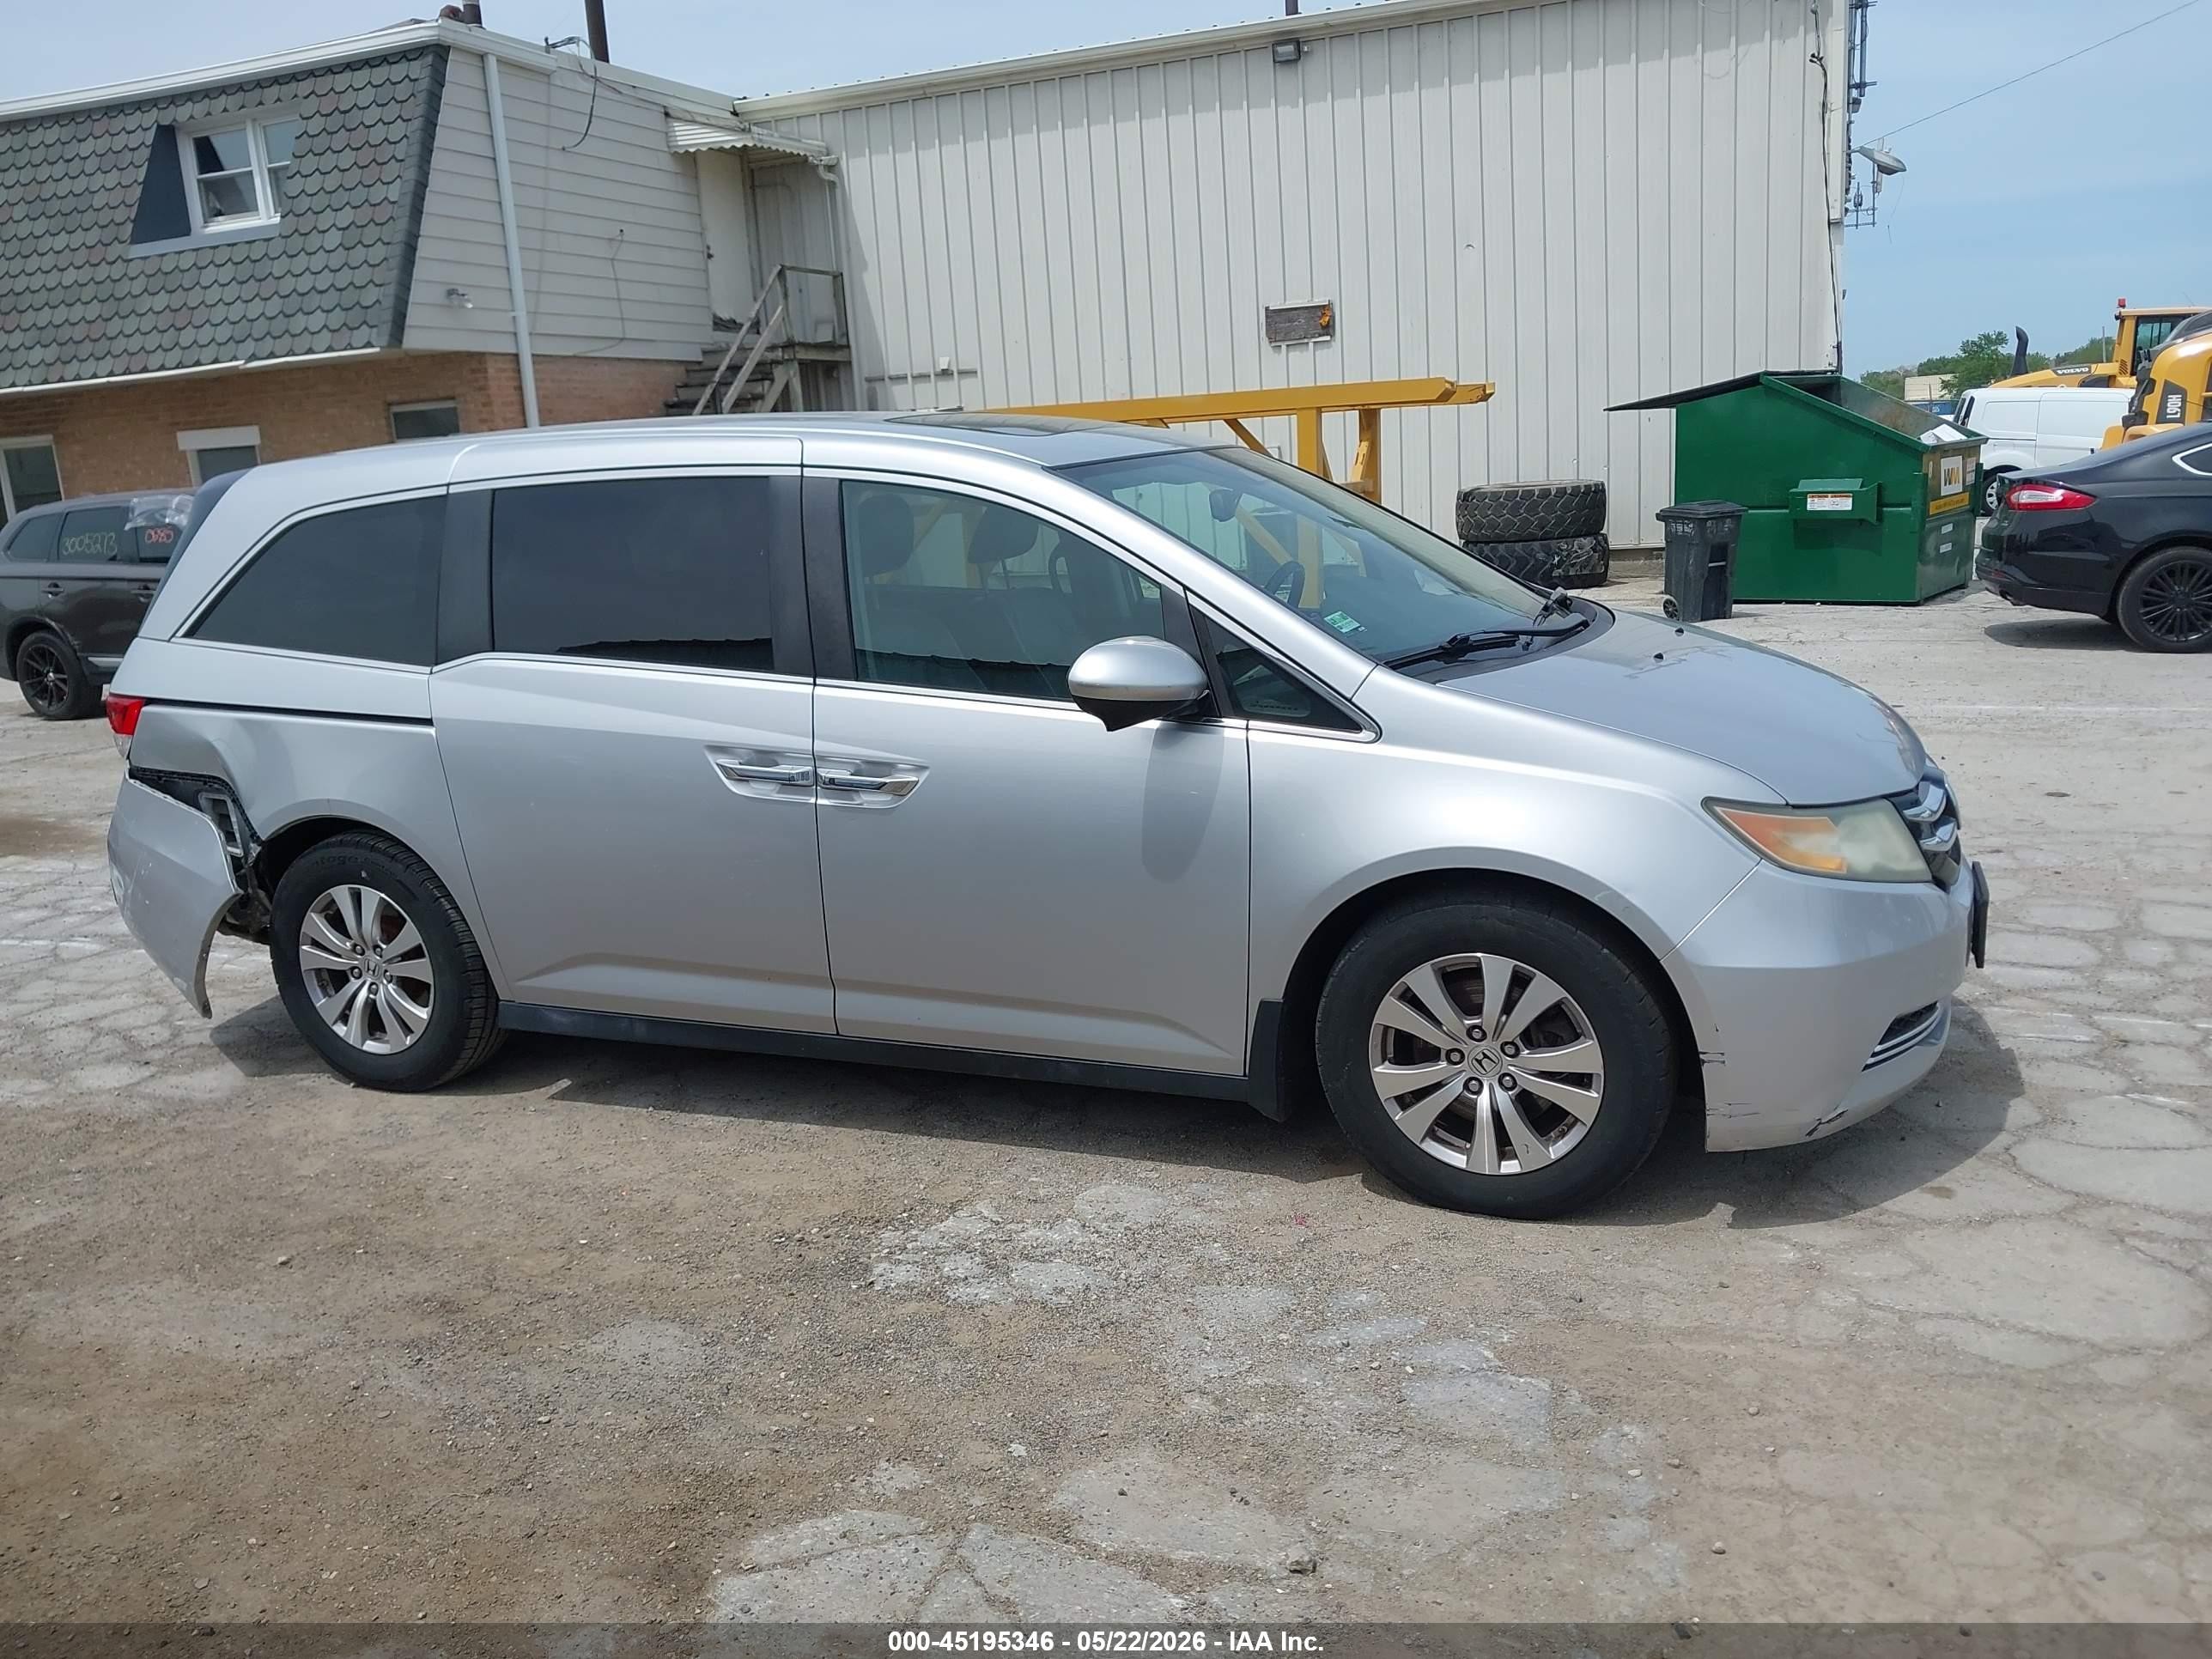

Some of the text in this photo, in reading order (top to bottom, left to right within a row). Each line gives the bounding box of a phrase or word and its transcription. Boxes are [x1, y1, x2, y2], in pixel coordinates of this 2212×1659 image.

[2166, 394, 2183, 419] L90H
[1943, 466, 1960, 487] WM
[62, 532, 118, 556] 3005273
